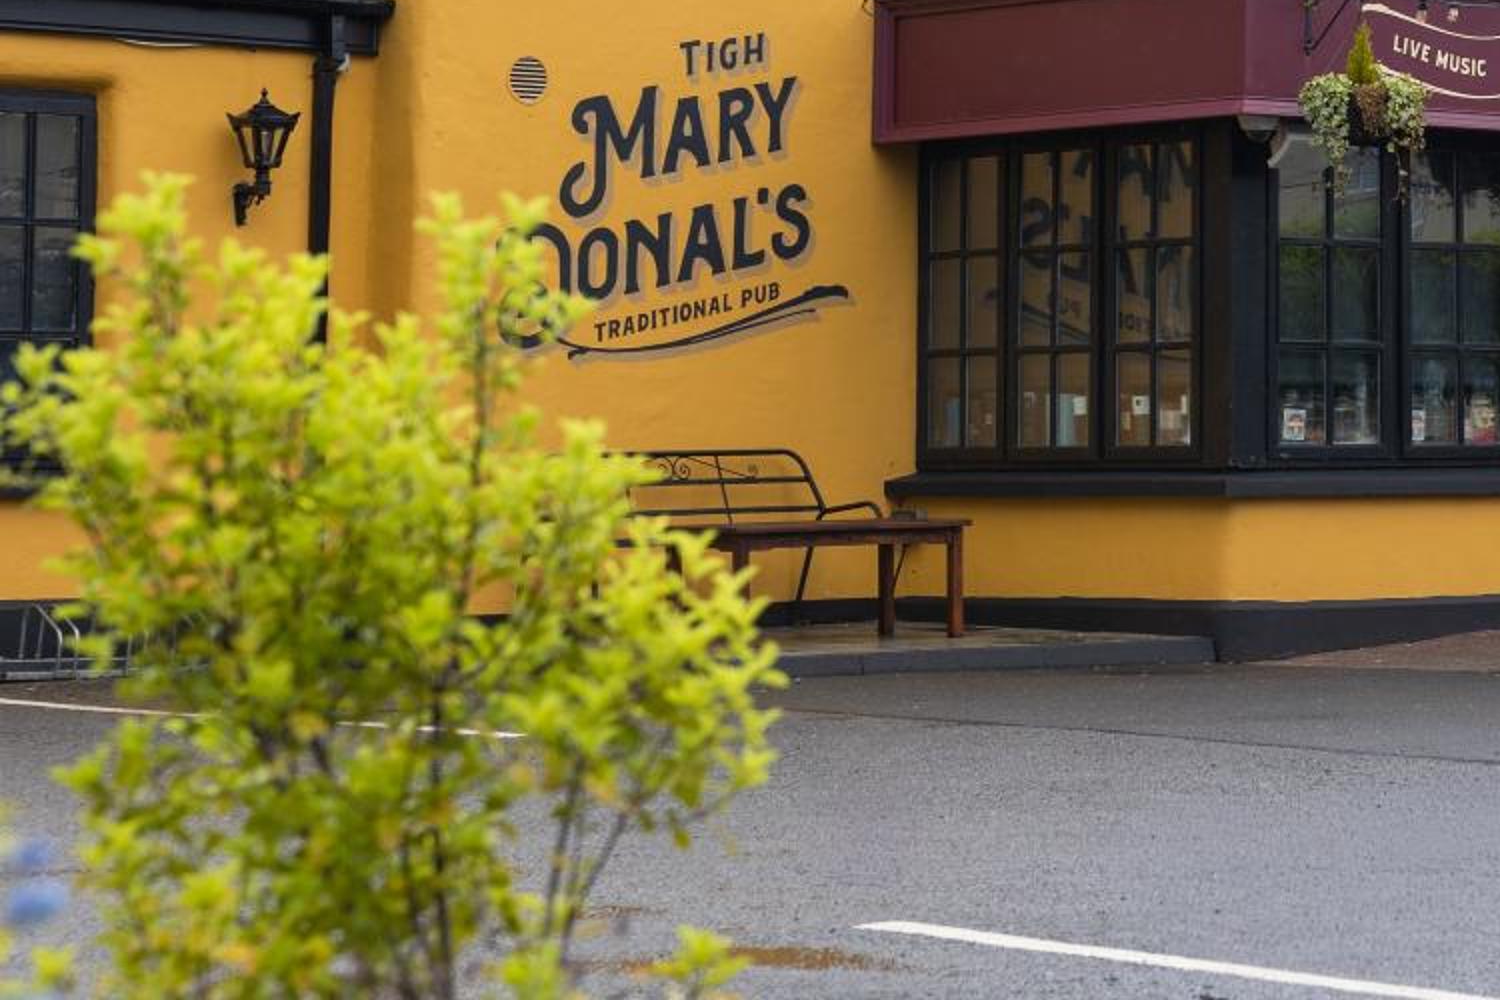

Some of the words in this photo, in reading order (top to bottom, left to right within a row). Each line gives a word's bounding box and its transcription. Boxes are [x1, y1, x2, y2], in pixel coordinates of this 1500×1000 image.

[680, 33, 766, 76] TIGH
[1392, 34, 1430, 63] LIVE
[1436, 49, 1487, 77] MUSIC
[559, 76, 797, 218] MARY
[594, 299, 732, 342] TRADITIONAL
[740, 282, 780, 309] PUB
